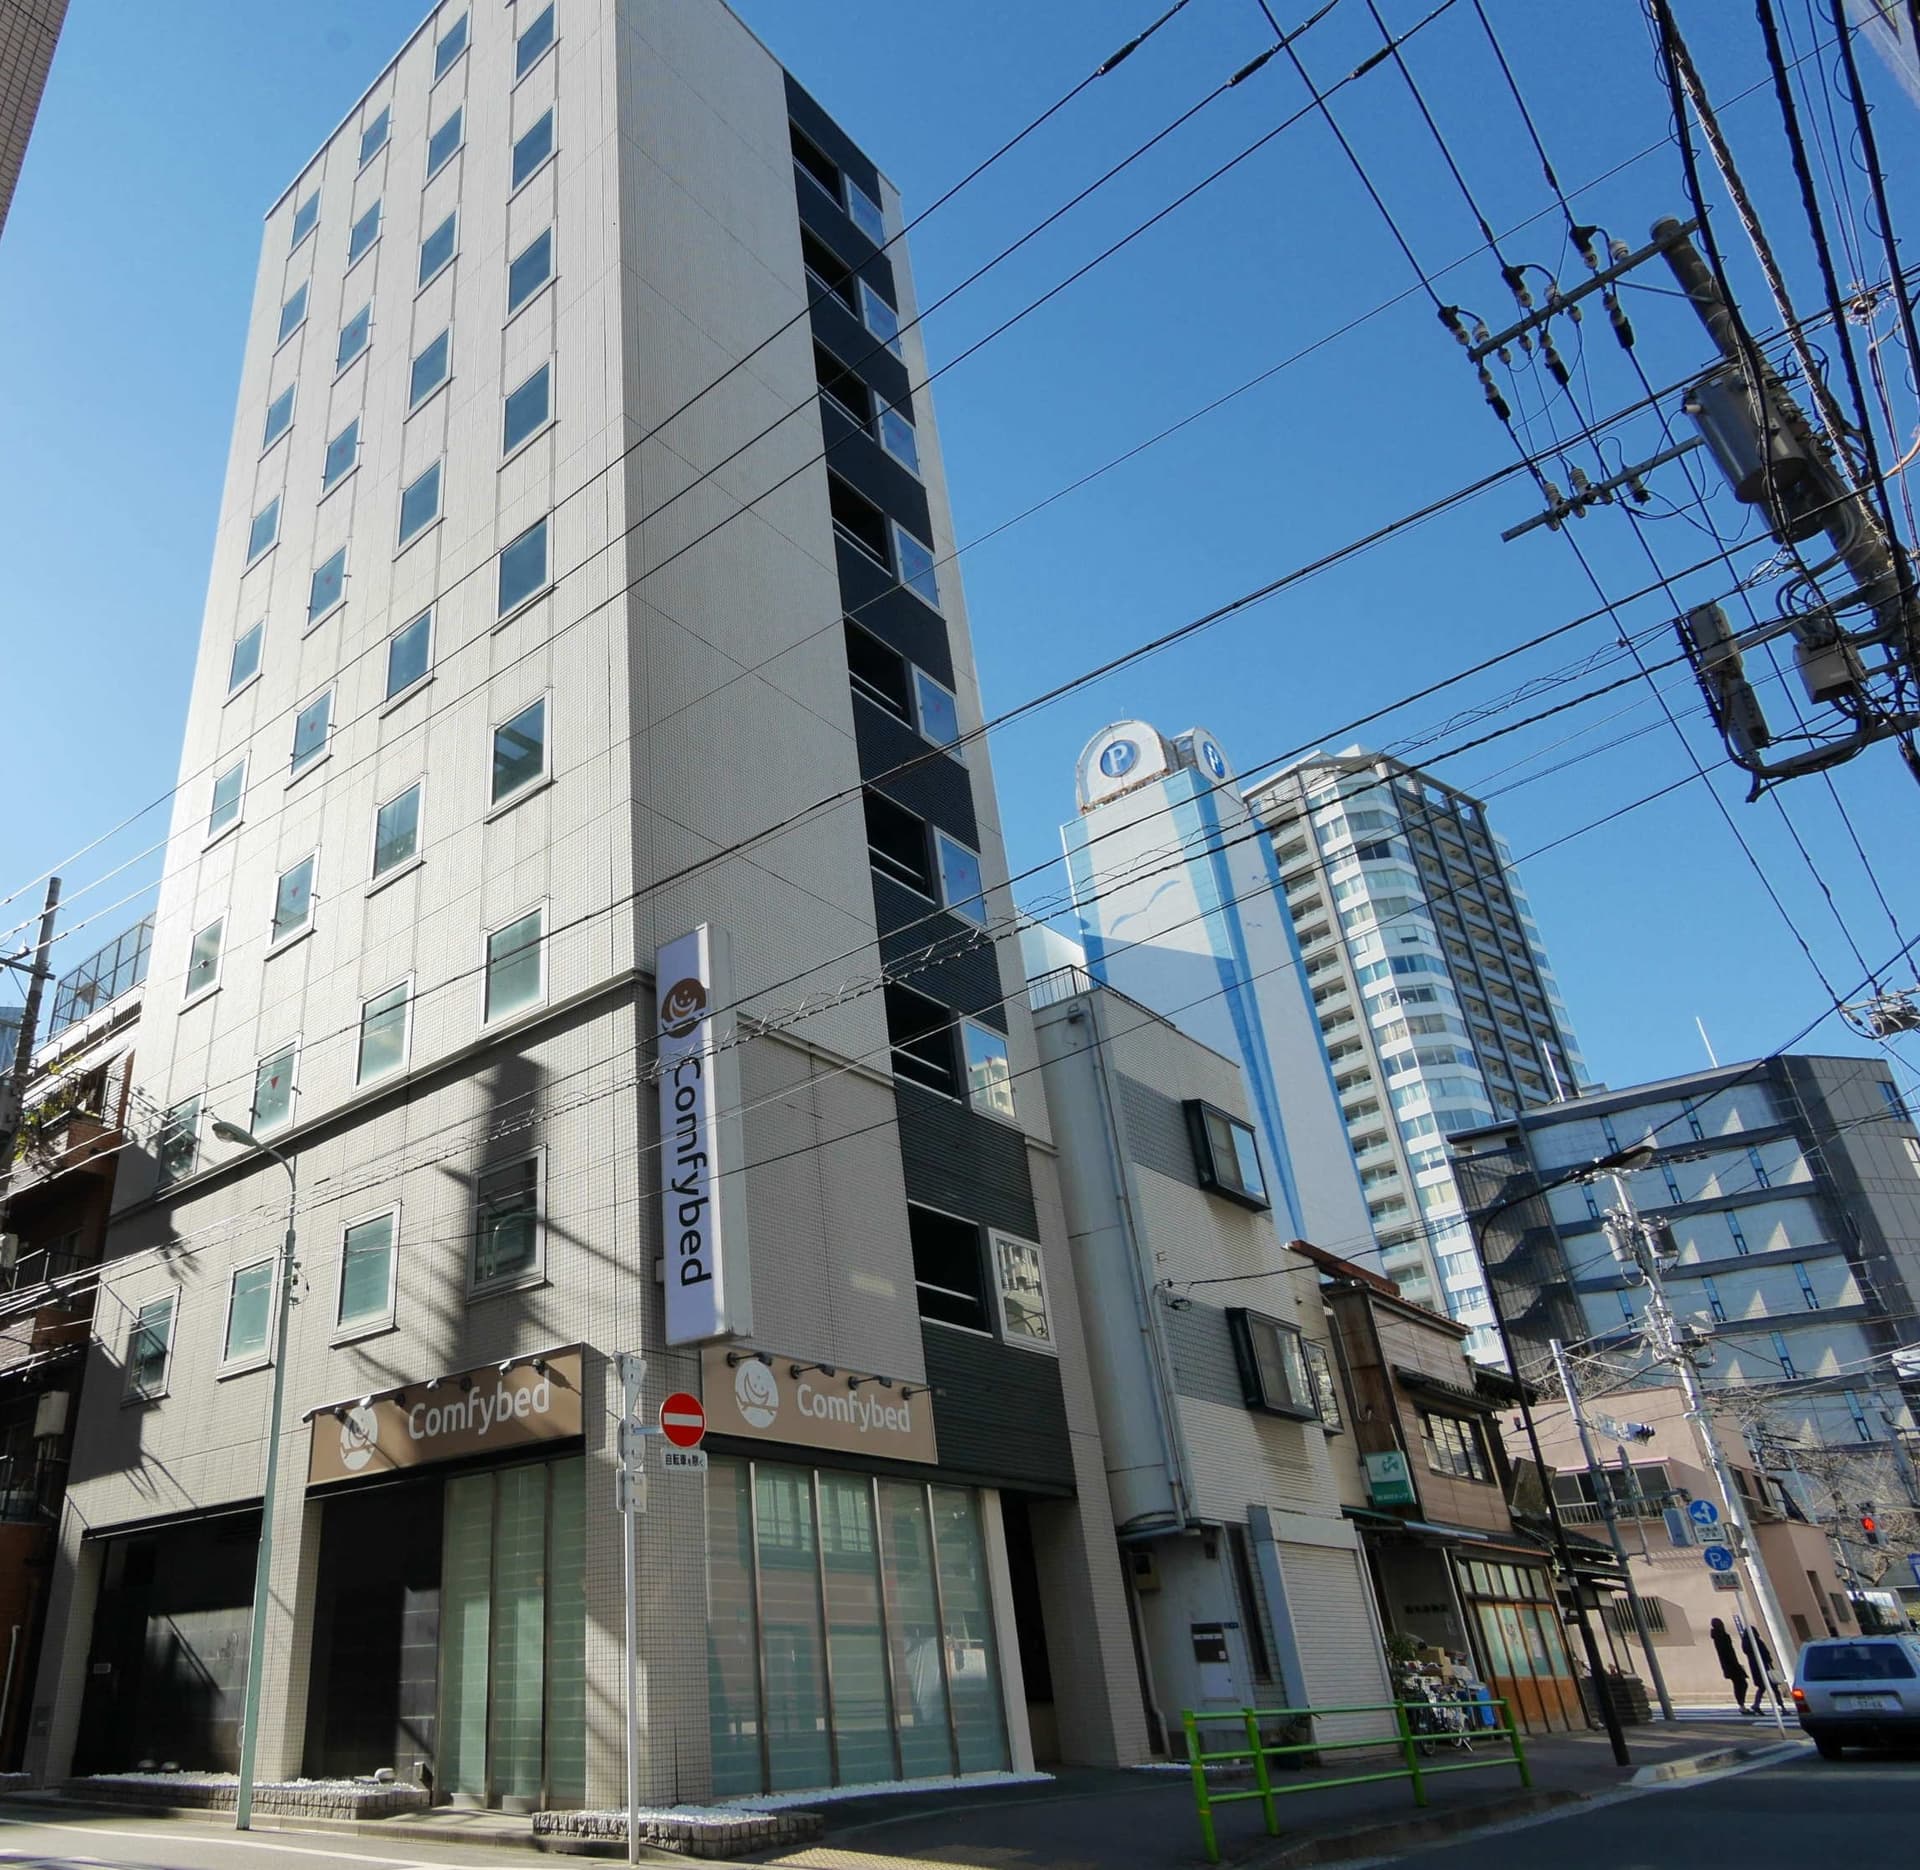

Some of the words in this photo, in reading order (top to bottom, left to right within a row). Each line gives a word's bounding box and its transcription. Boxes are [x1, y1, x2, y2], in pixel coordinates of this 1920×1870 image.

[1106, 744, 1129, 775] P
[671, 1056, 712, 1287] Comfybed
[408, 1369, 551, 1440] Comfybed
[796, 1384, 911, 1432] Comfybed
